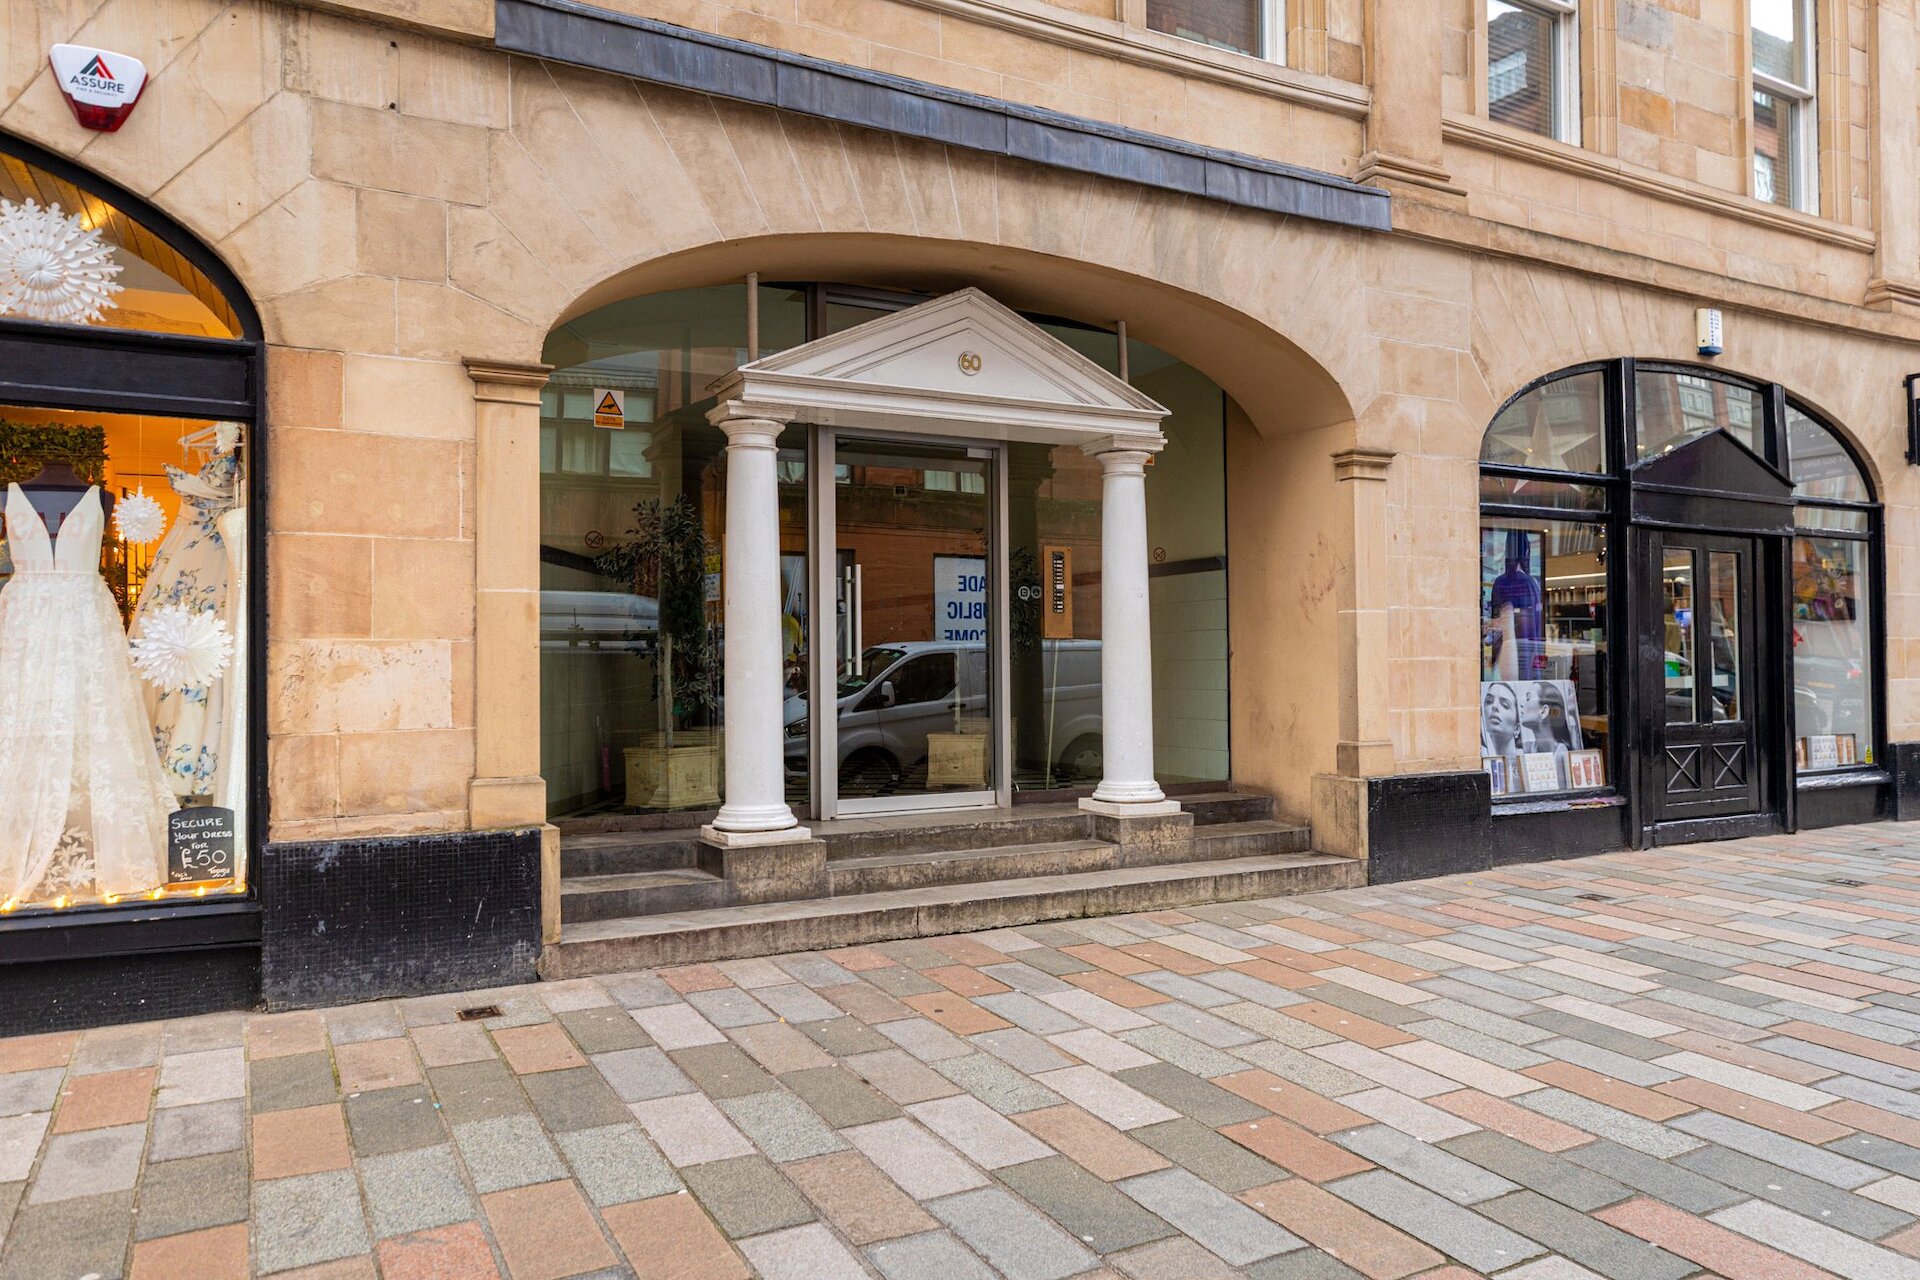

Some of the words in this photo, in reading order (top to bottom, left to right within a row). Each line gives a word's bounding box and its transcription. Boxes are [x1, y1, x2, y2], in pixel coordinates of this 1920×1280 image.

[70, 75, 125, 94] ASSURE
[961, 353, 982, 371] 60
[171, 818, 223, 829] SECURE
[202, 831, 233, 839] DRESS
[191, 842, 209, 850] FOR
